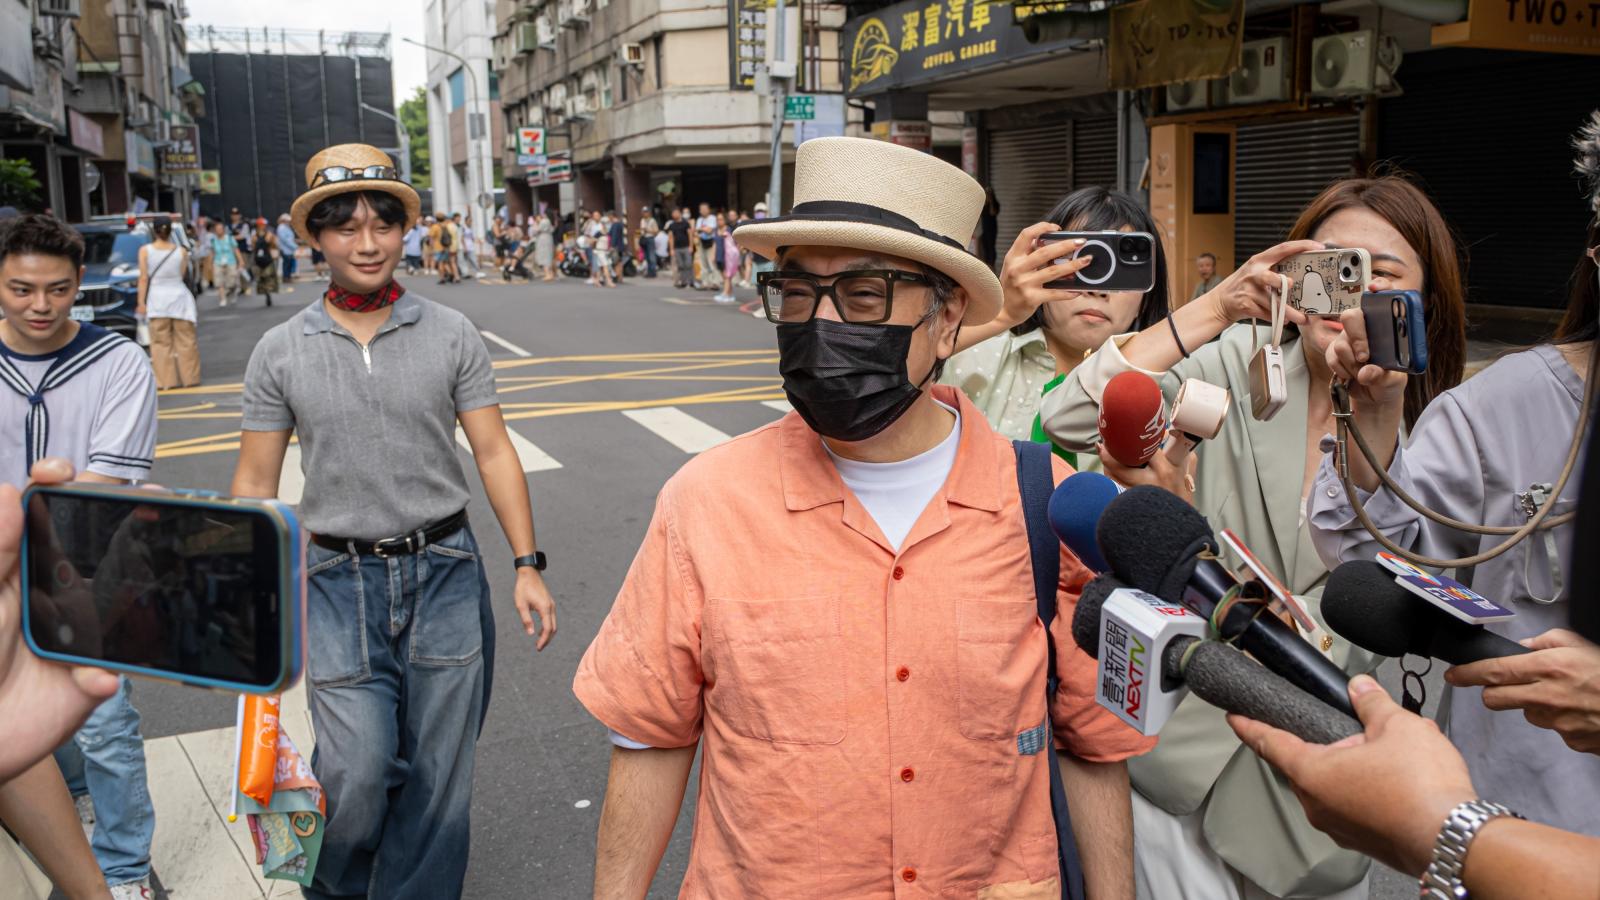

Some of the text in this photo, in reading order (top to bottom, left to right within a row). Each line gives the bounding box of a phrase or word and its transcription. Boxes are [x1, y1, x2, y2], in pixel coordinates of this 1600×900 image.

[923, 39, 997, 69] JOYFUL GARAGE
[1103, 619, 1128, 710] 壹新聞
